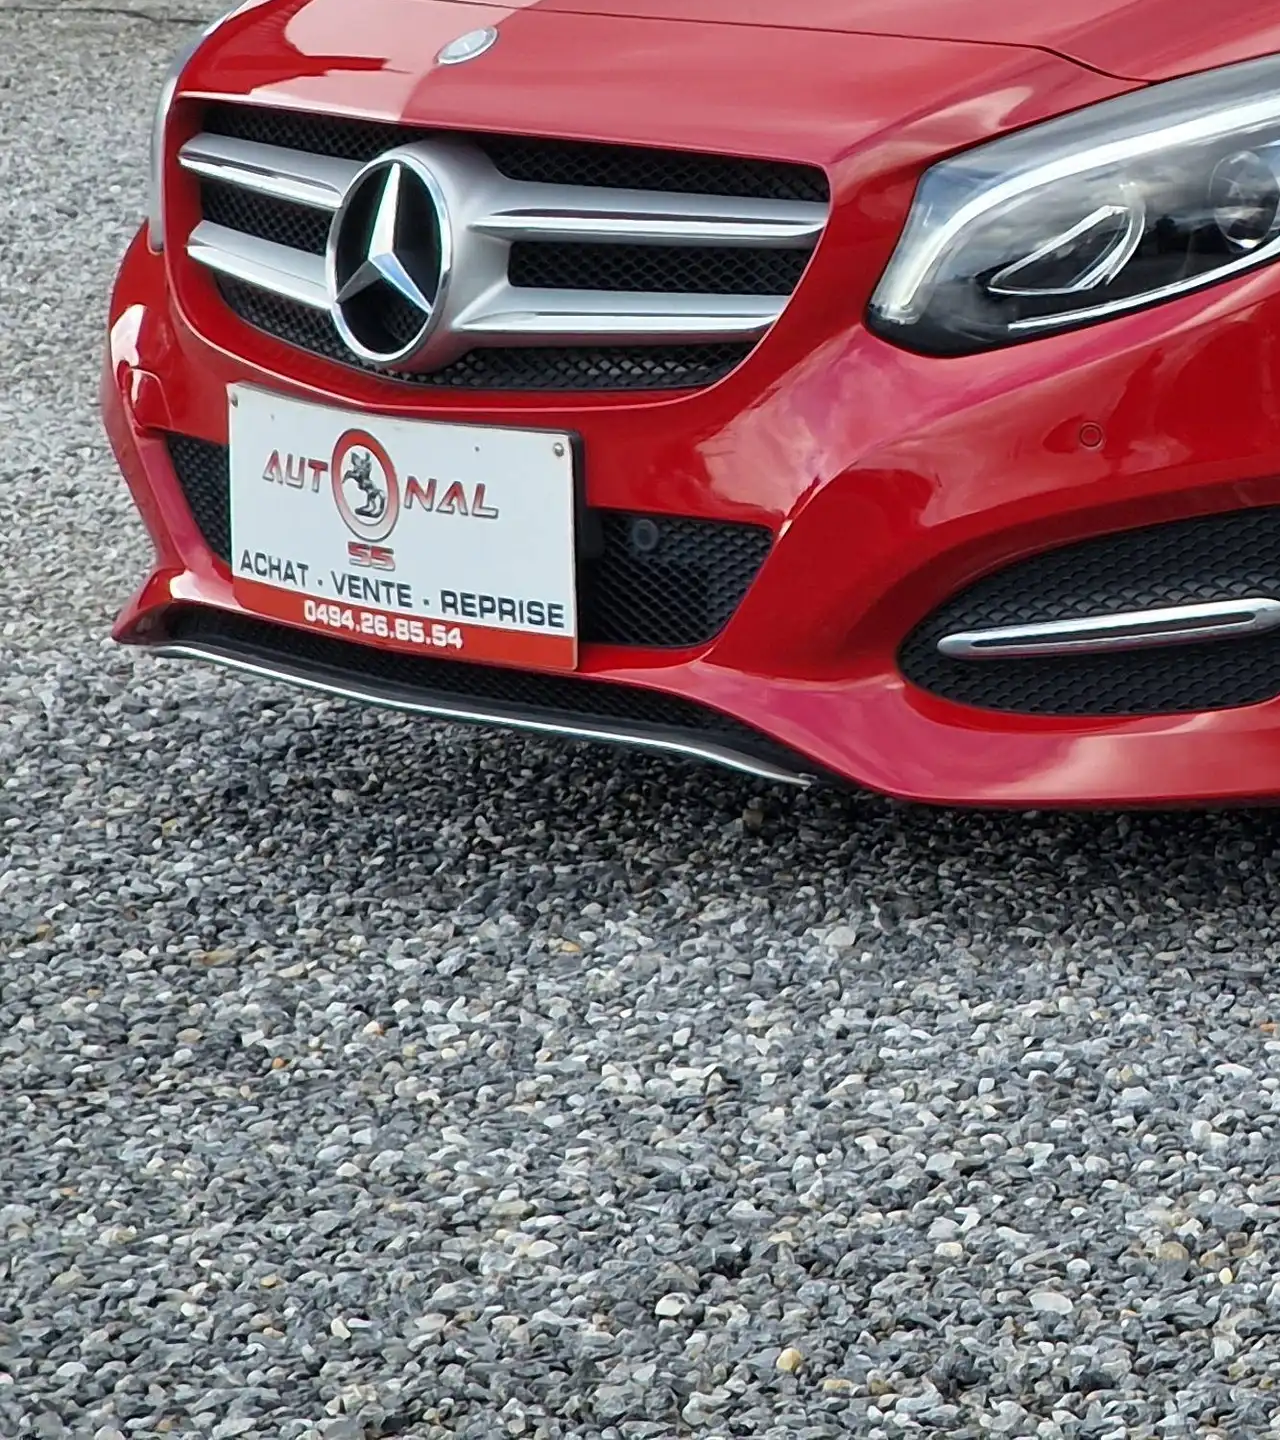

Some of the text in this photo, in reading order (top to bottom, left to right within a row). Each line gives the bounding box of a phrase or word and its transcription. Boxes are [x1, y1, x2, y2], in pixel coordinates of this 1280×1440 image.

[347, 541, 397, 571] 55
[239, 548, 566, 629] ACHAT VENTE REPRISE
[303, 599, 464, 650] 0494.26.85.54
